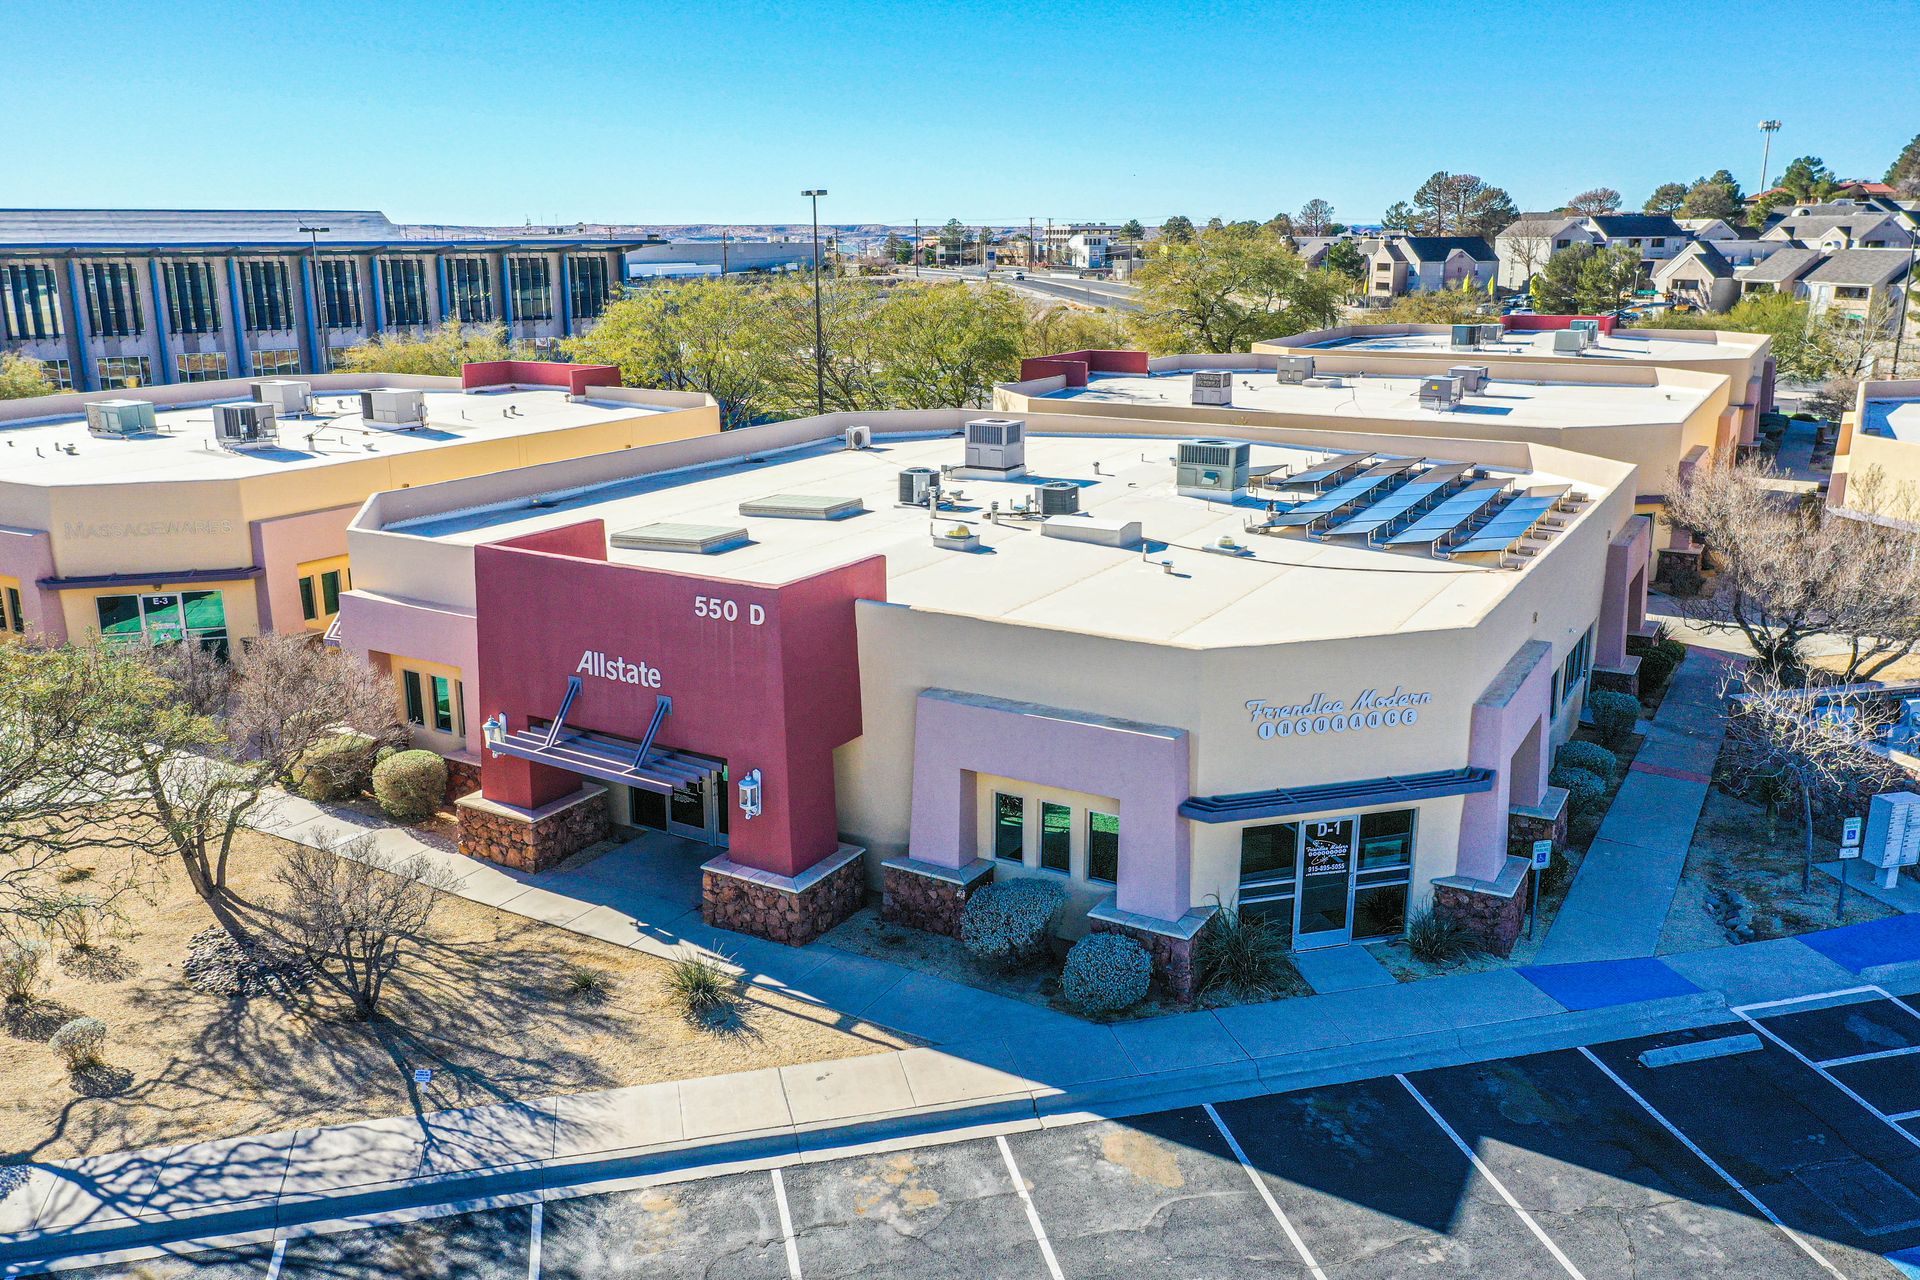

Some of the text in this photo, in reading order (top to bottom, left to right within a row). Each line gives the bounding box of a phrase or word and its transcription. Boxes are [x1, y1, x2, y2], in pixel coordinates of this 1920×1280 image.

[152, 597, 169, 605] E-3
[694, 596, 766, 626] 550 D
[575, 650, 662, 689] Allstate
[1245, 686, 1432, 723] Friendlee Modern
[1259, 708, 1417, 740] INSURANCE
[1317, 821, 1341, 837] D-1
